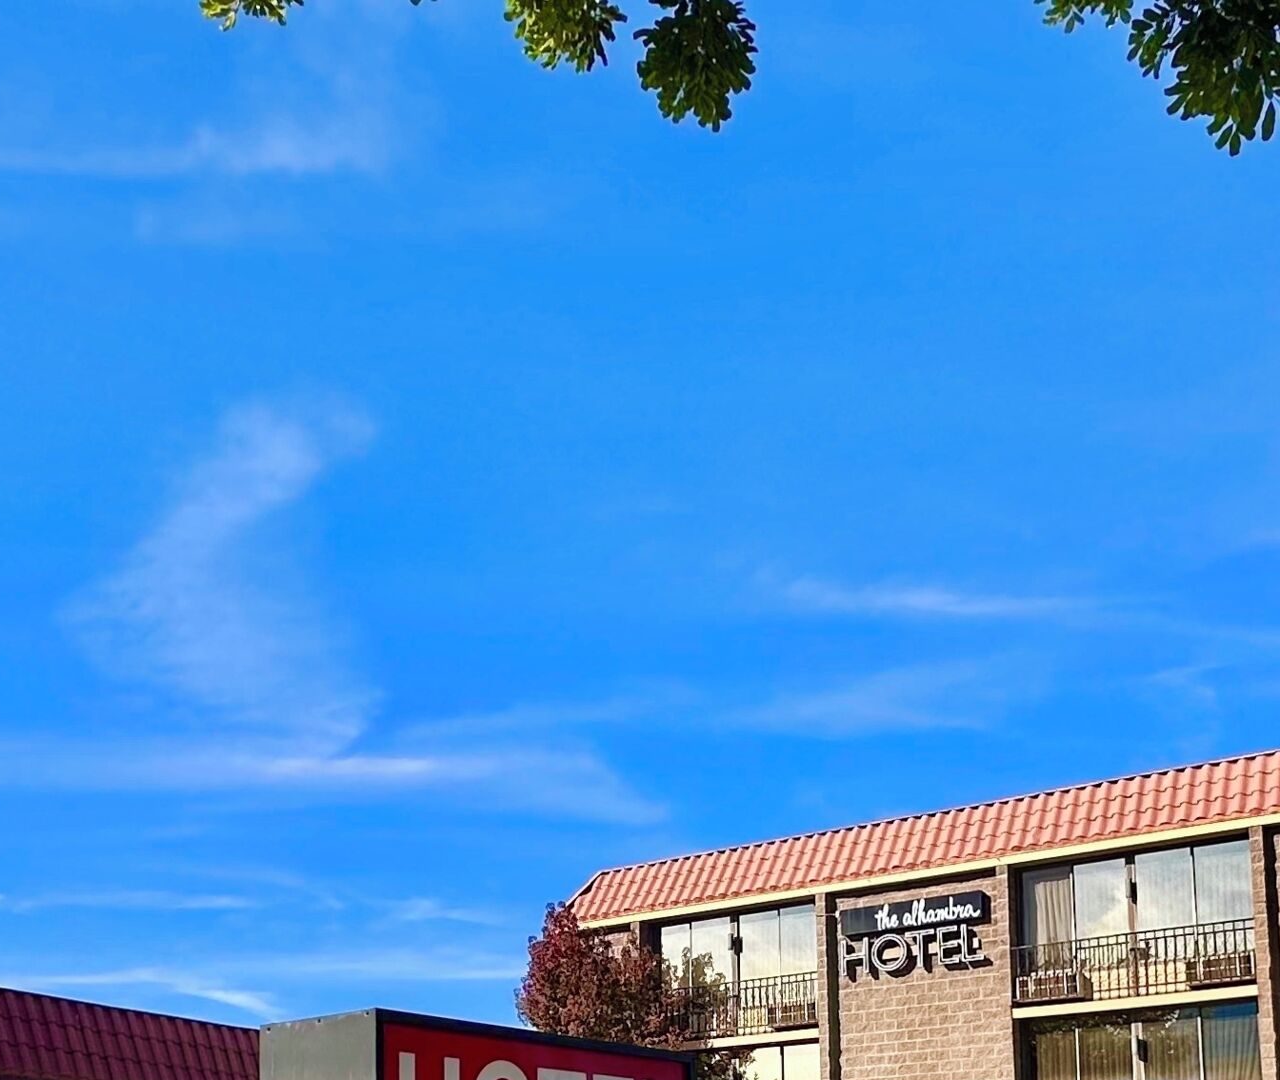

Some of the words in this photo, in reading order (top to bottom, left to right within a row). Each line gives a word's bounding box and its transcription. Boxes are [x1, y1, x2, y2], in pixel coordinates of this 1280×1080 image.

[874, 903, 899, 930] the
[902, 897, 981, 927] alhambra
[839, 924, 984, 976] HOTEL
